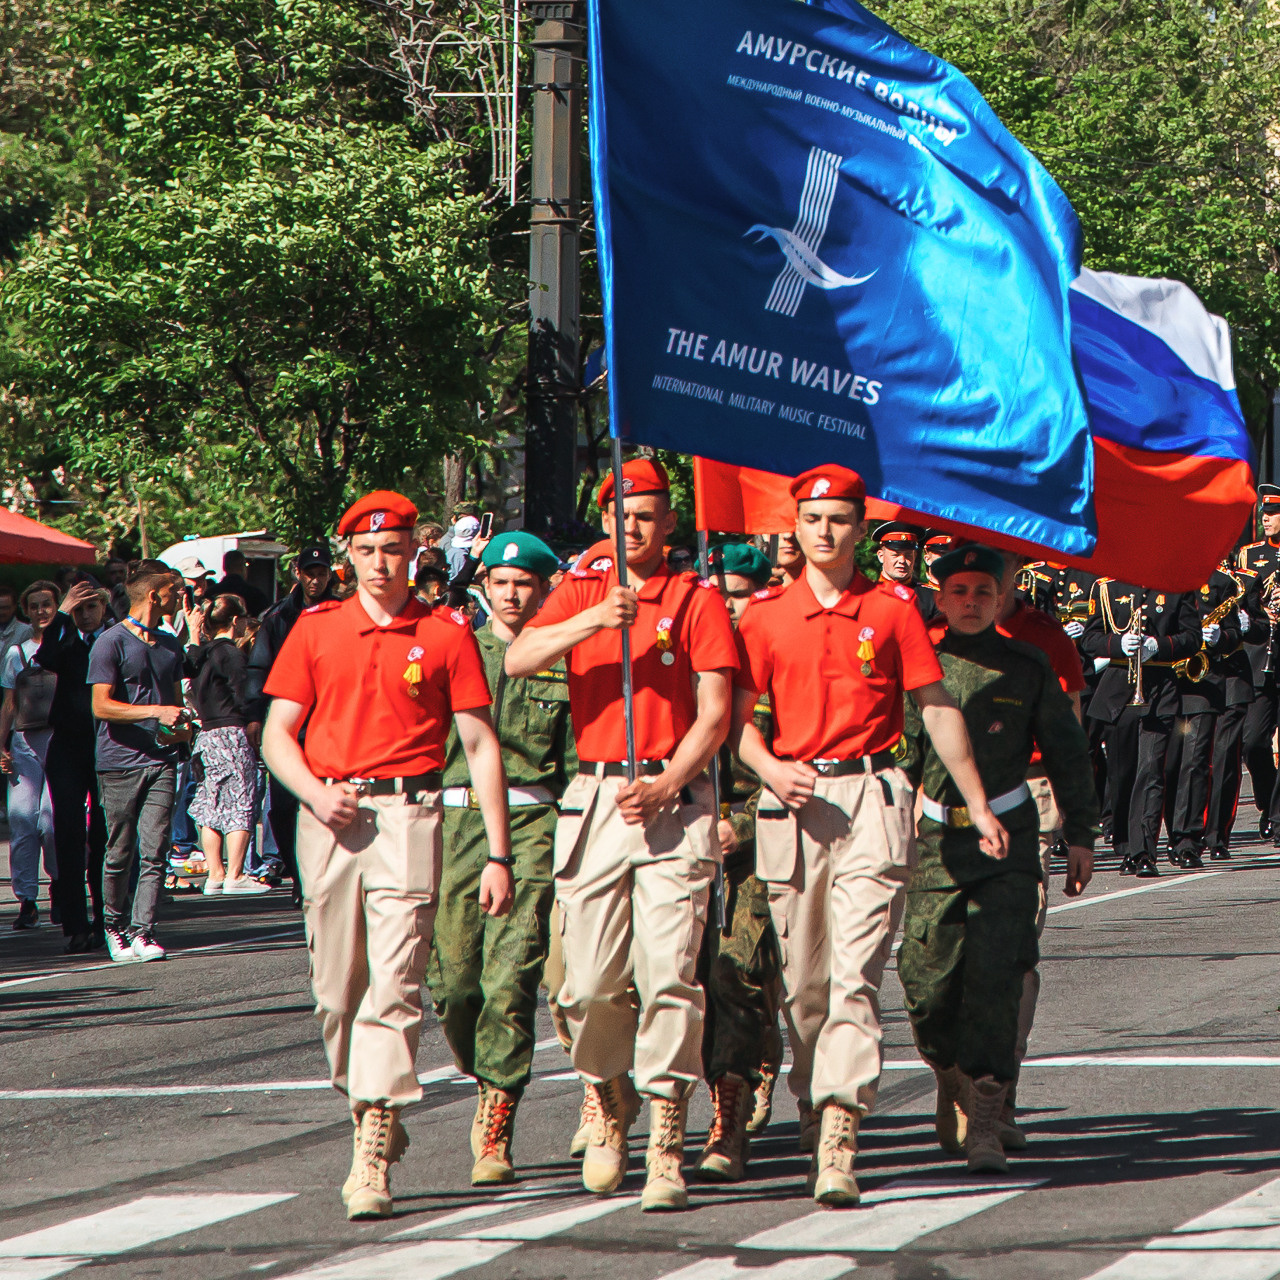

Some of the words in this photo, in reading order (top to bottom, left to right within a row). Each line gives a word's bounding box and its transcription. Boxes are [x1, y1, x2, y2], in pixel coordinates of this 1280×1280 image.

[736, 30, 872, 91] АМУРСКИЕ
[727, 74, 802, 101] МЕЖДУНАРОДНЫЙ
[804, 93, 907, 141] ВОЕННО-МУЗЫКАЛЬНЫЙ
[666, 328, 709, 361] THE
[710, 339, 783, 379] AMUR
[790, 357, 883, 405] WAVES
[651, 374, 724, 404] INTERNATIONAL
[727, 392, 775, 416] MILITARY
[778, 404, 815, 426] MUSIC
[817, 414, 867, 440] FESTIVAL
